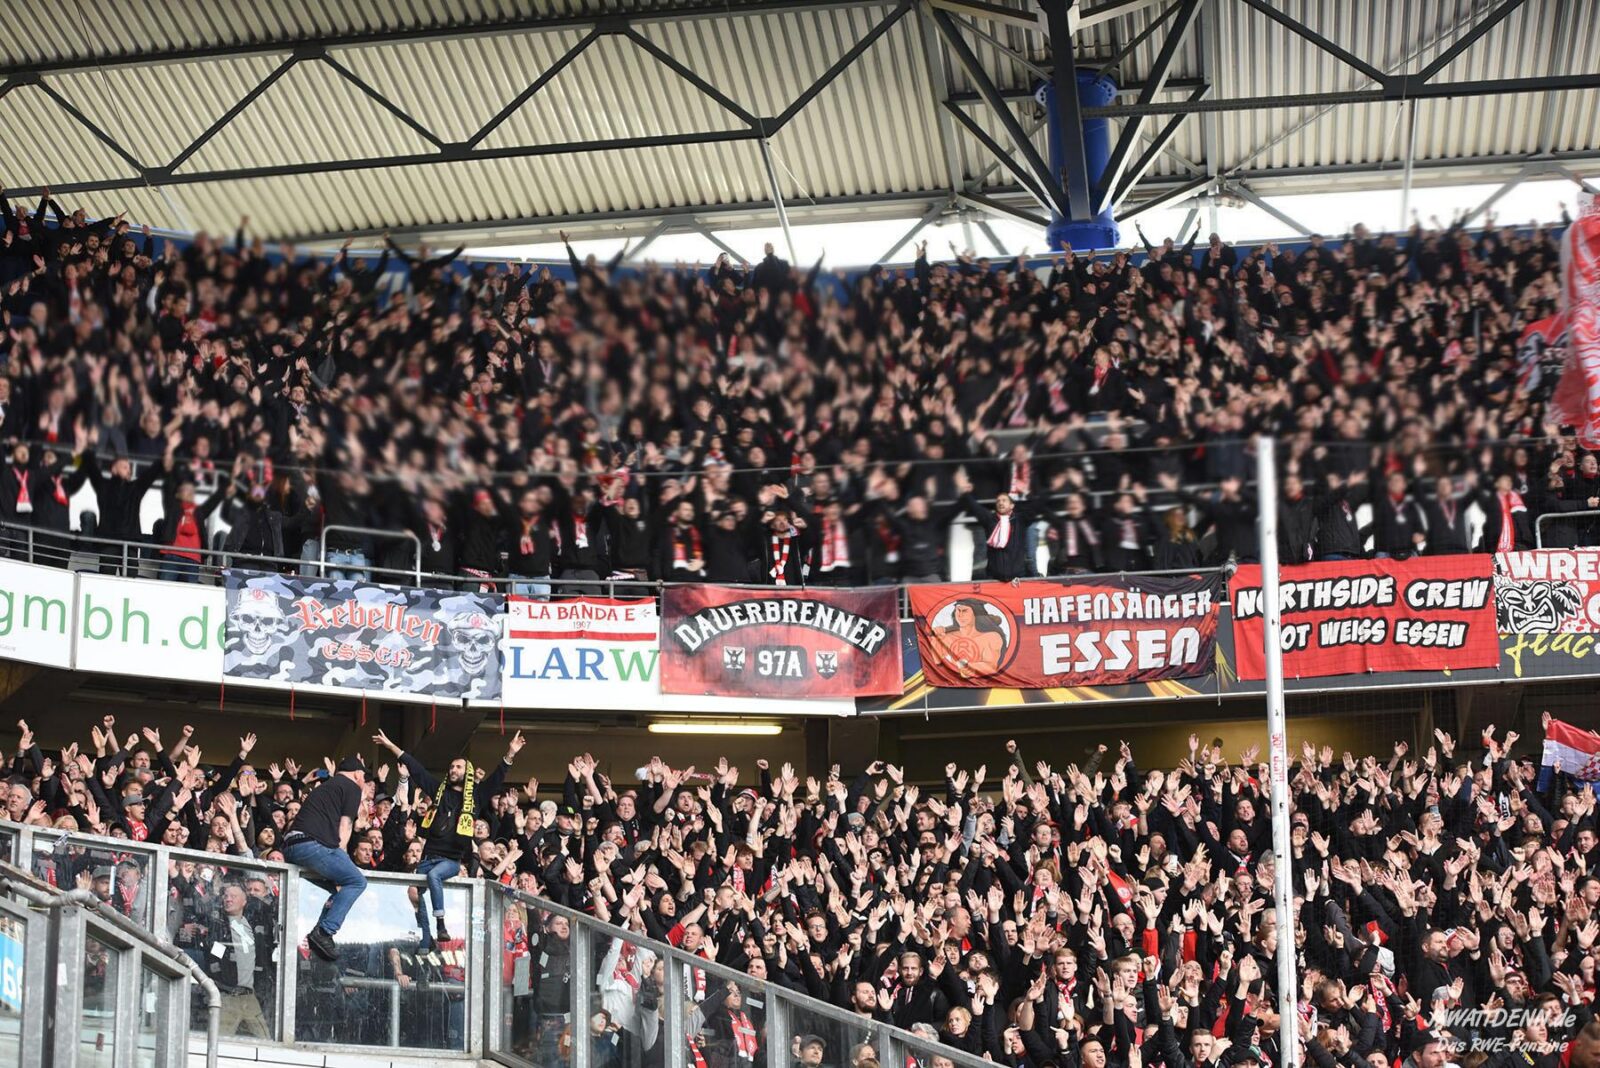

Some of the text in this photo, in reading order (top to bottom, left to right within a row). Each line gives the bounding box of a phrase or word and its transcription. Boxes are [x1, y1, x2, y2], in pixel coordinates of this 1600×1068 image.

[1494, 551, 1600, 580] WRE
[527, 604, 636, 622] LA BANDA E
[1024, 587, 1212, 625] HAFENSÄNGER
[1237, 577, 1490, 618] NRTHSIDE CREW
[0, 589, 226, 650] gmbh.d
[290, 599, 444, 646] Rebellen
[674, 599, 887, 656] DAUERBRENNER
[1280, 619, 1467, 650] OT WEISS ESSEN
[500, 646, 661, 682] LARW
[758, 650, 803, 677] 97A
[1040, 627, 1201, 676] ESSEN
